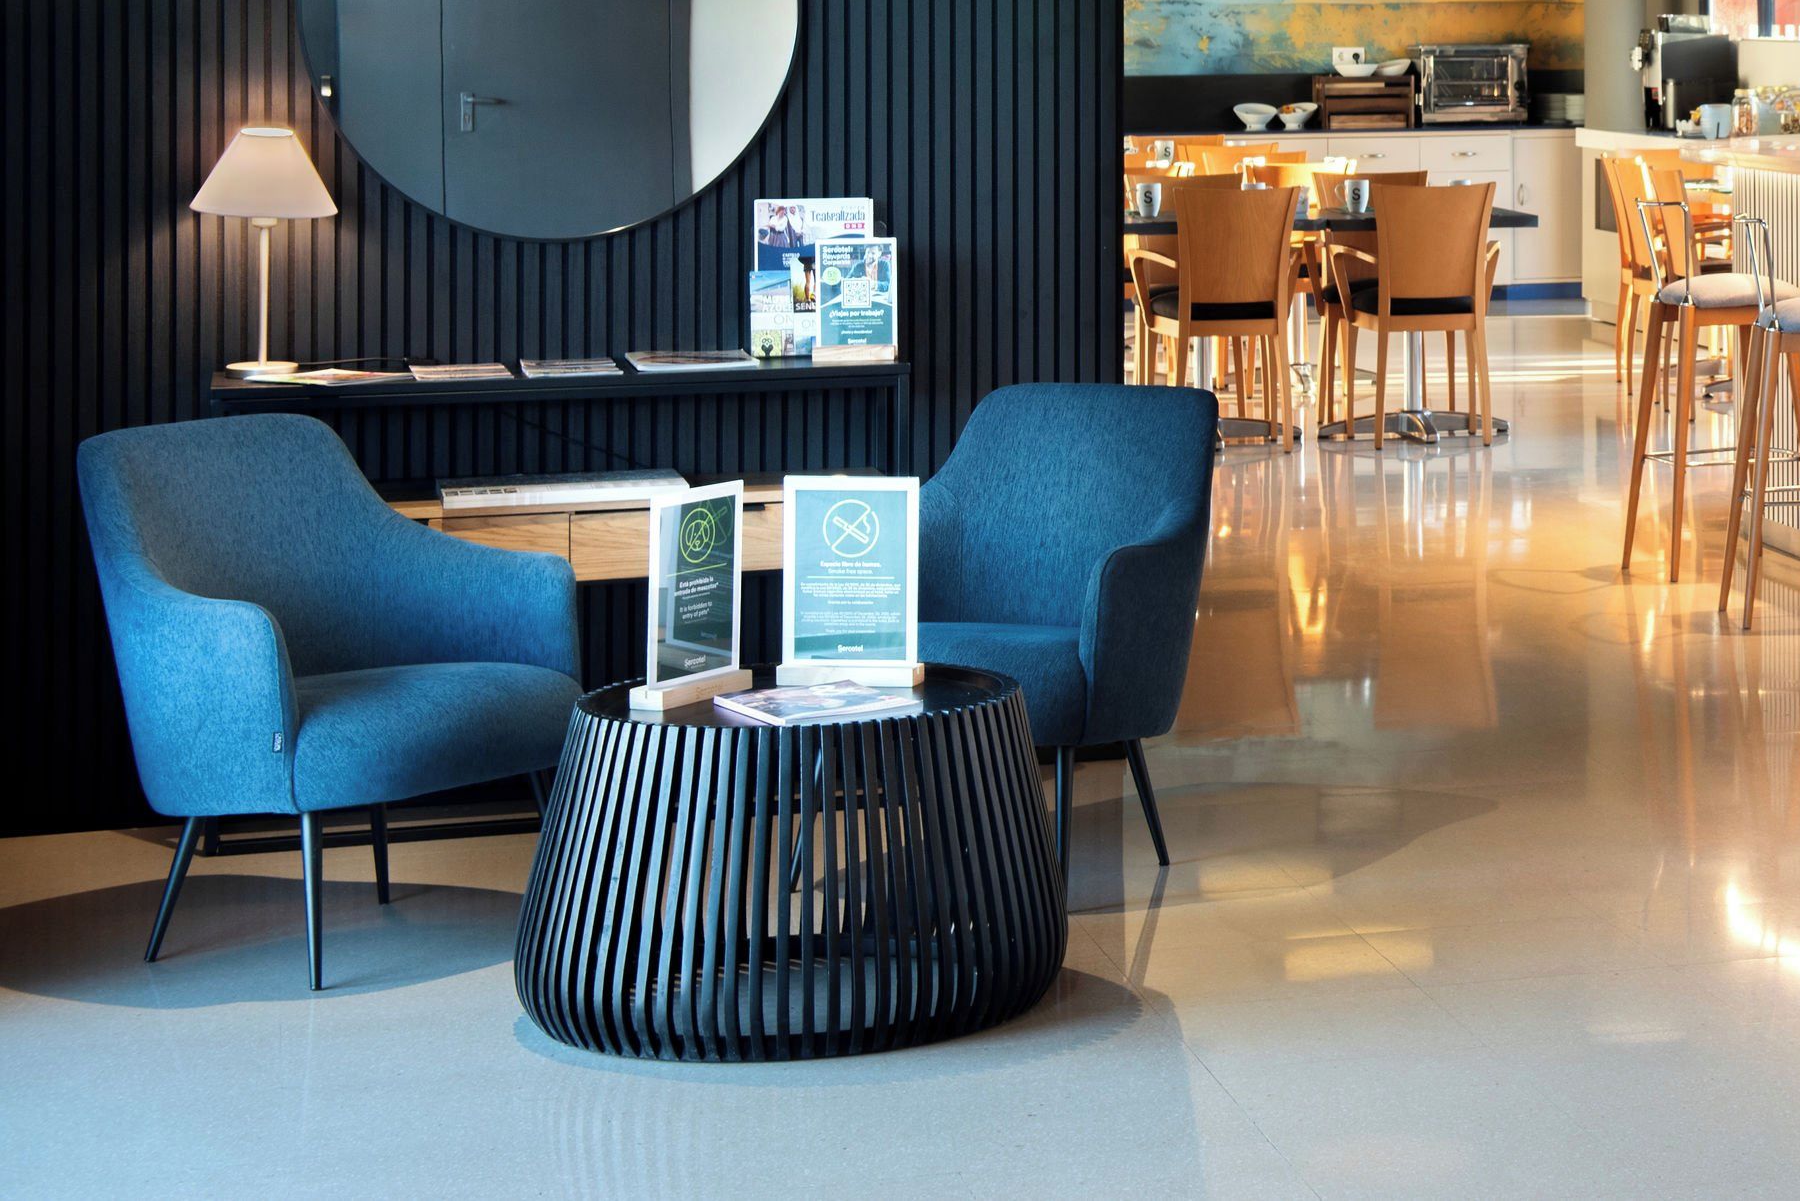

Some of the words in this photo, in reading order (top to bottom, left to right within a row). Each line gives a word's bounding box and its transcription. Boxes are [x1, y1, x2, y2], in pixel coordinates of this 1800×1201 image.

[1163, 146, 1171, 158] S
[1143, 190, 1153, 204] S
[1352, 187, 1361, 201] S
[811, 209, 866, 222] Teatralizada
[837, 644, 864, 653] Sercotel
[684, 654, 706, 667] Sercotel
